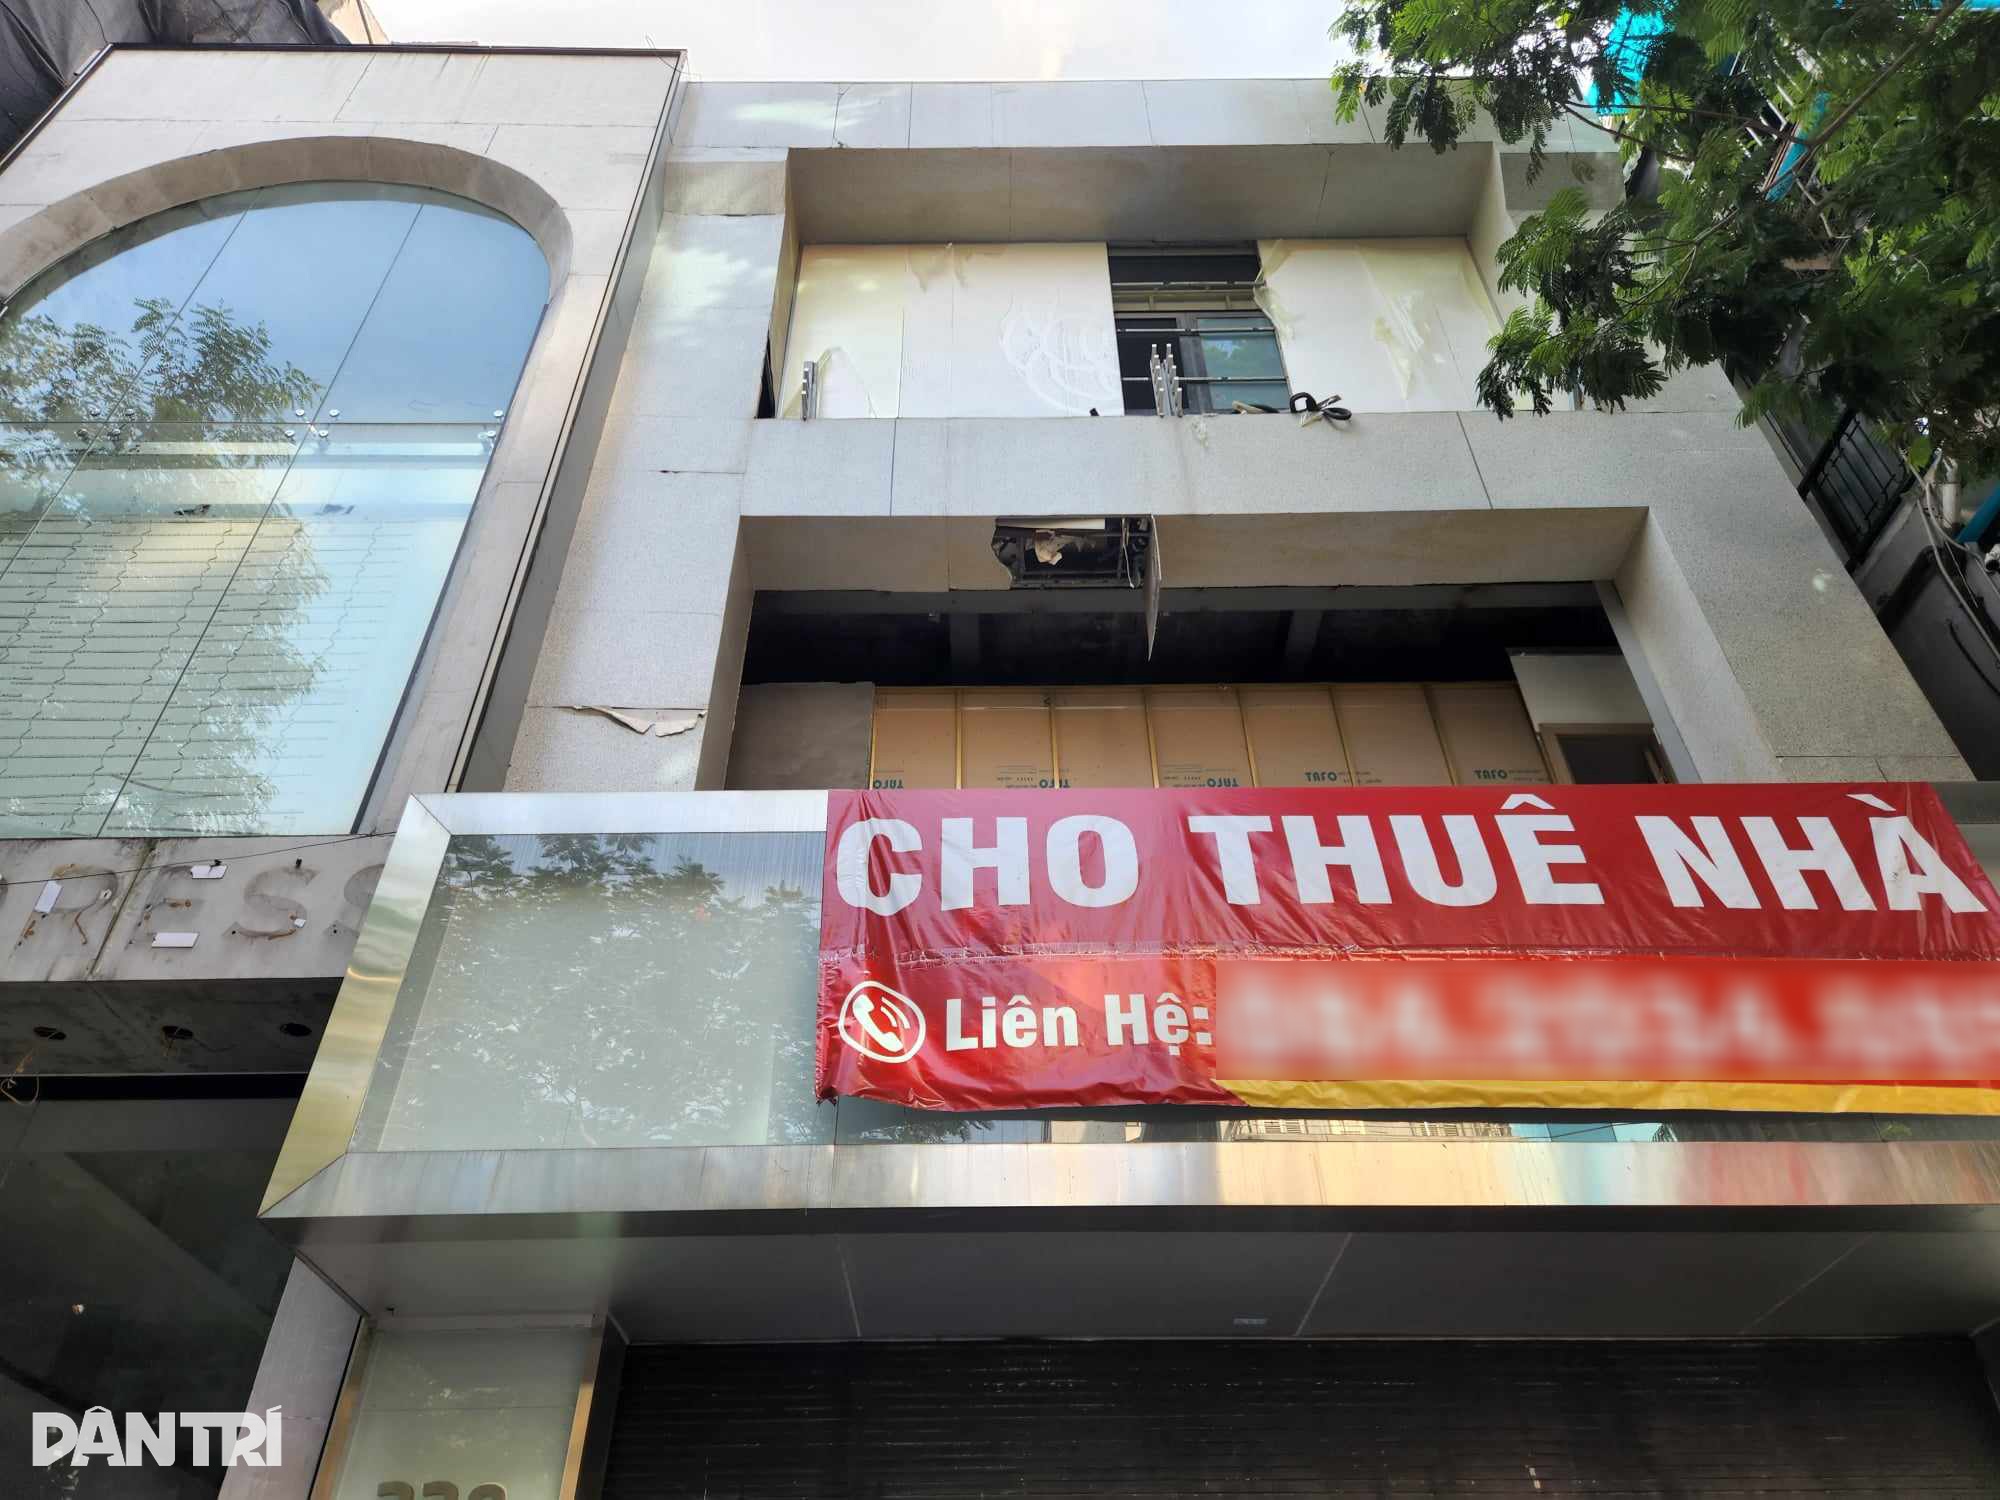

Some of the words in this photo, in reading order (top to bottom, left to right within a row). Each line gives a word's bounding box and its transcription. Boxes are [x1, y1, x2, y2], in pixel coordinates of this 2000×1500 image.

[836, 815, 1139, 916] CHO
[1188, 793, 1604, 907] THUÊ
[1634, 793, 1988, 913] NHÀ
[946, 995, 1079, 1051] Liên
[1104, 993, 1213, 1055] Hệ:
